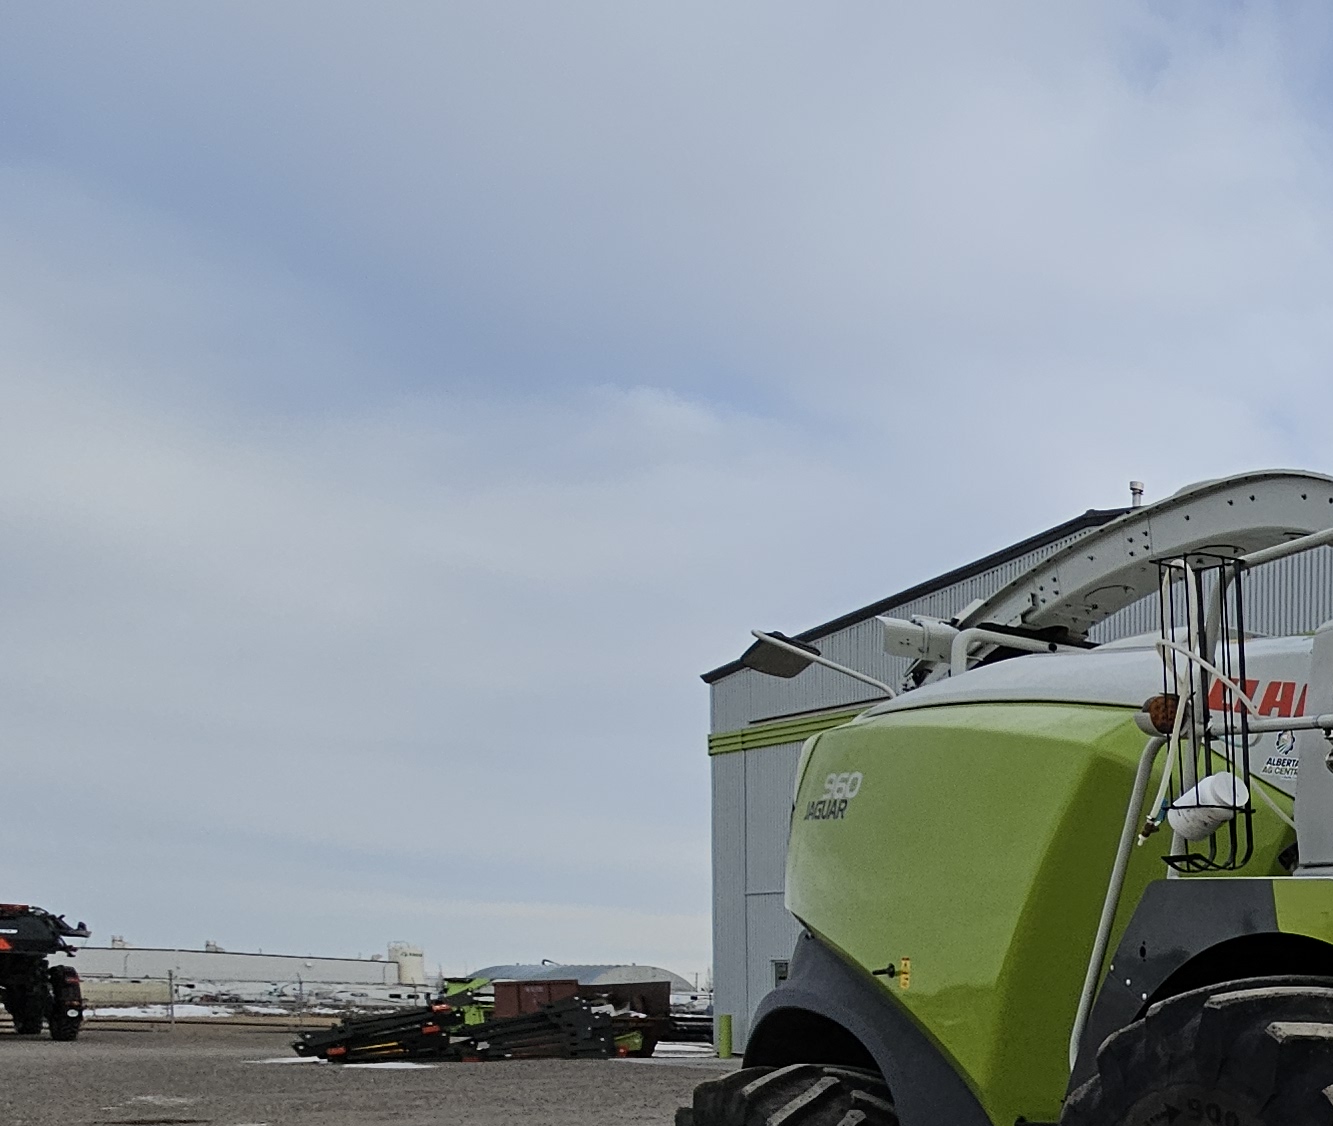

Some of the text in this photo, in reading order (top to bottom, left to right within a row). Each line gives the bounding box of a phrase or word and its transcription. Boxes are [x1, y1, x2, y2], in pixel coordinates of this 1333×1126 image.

[1262, 766, 1273, 774] AG
[822, 771, 863, 799] 960
[804, 799, 848, 820] JAGUAR
